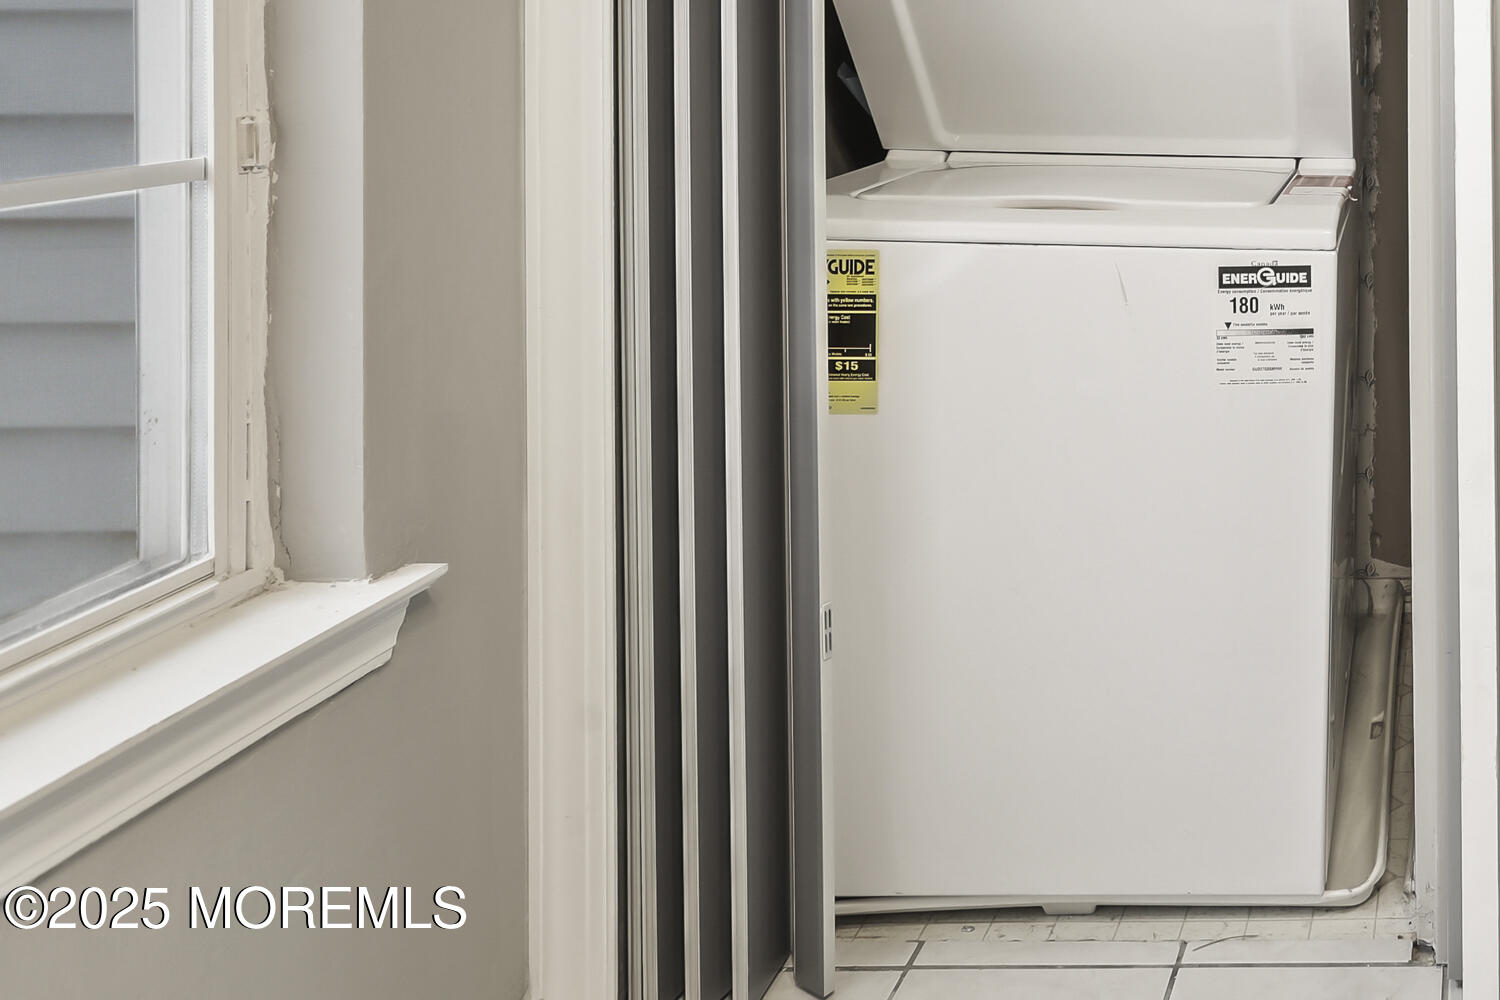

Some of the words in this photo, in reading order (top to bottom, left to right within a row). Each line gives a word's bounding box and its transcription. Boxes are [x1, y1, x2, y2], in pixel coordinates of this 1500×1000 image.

[827, 259, 875, 275] GUIDE
[1222, 267, 1308, 287] ENERGUIDE
[1230, 297, 1258, 314] 180
[835, 361, 859, 371] $15
